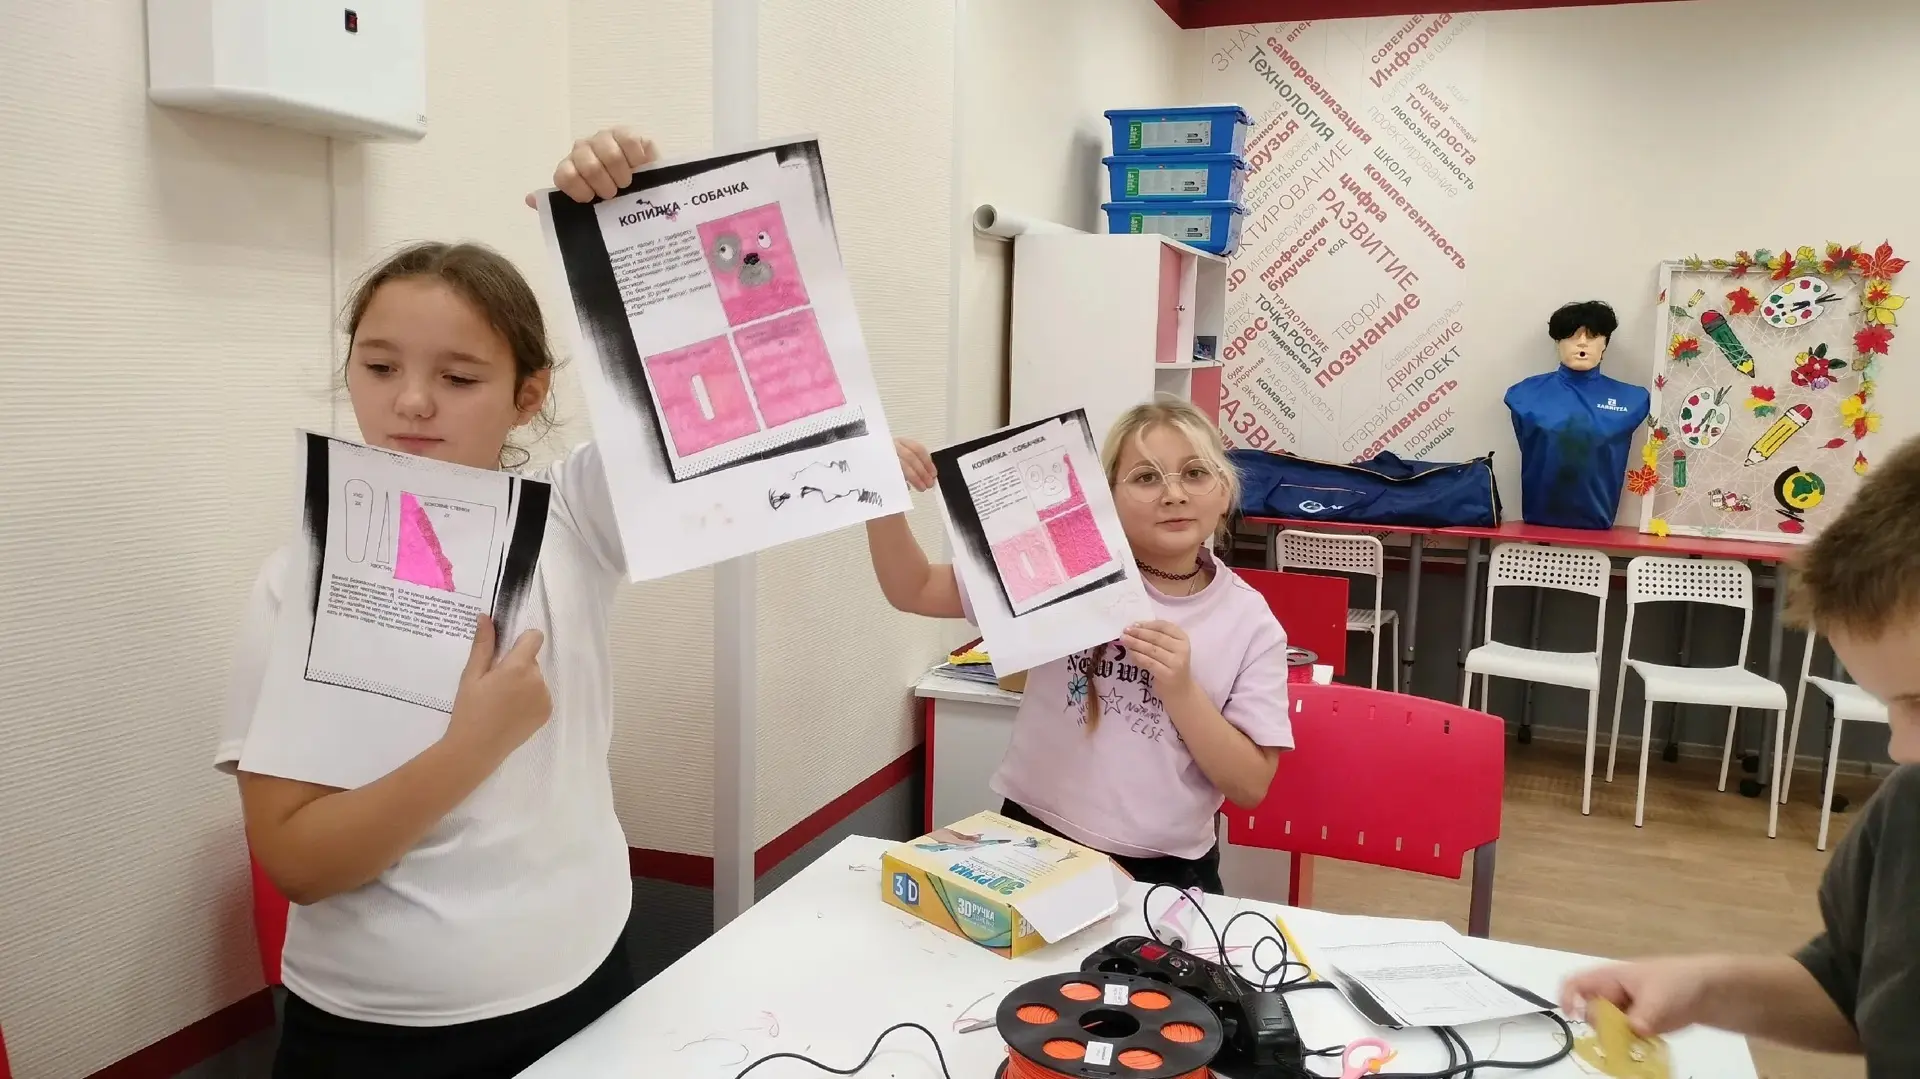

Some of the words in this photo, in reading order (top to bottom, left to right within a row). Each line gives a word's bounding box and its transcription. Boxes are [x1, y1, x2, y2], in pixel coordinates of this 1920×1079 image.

[1248, 45, 1334, 142] Технология
[1266, 36, 1372, 145] самореализация
[1416, 83, 1450, 113] думай
[1373, 146, 1412, 187] ШКОЛА
[1391, 105, 1474, 190] ЛЮБОЗНАТЕЛЬНОСТЬ
[1244, 163, 1284, 207] АСНОСТИ
[1250, 141, 1320, 209] ДЕЯТЕЛЬНОСТИ
[1339, 173, 1387, 223] цифра
[618, 201, 680, 228] КОПИЛКА
[691, 181, 749, 207] СОБАЧКА
[1364, 164, 1466, 270] компетентность
[1260, 217, 1328, 282] профессии
[1268, 238, 1327, 291] будущего
[1317, 188, 1419, 292] РАЗВИТИЕ
[1328, 239, 1348, 256] код
[1223, 317, 1268, 360] ерес
[1255, 293, 1290, 332] ТОЧКА
[1287, 329, 1323, 367] РОСТА
[1273, 293, 1329, 353] ТРУДОЛЮБИЕ
[1314, 293, 1420, 389] познание
[1227, 365, 1244, 380] будь
[1268, 329, 1312, 374] лидерство
[1387, 322, 1463, 392] движение
[1405, 346, 1462, 397] ПРОЕКТ
[1256, 377, 1296, 420] команда
[1264, 368, 1297, 405] РАБОТА
[1242, 384, 1296, 444] аккуратность
[1352, 380, 1458, 463] реативность
[1404, 407, 1455, 452] порядок
[971, 451, 1008, 470] КОПИЛКА
[1012, 436, 1046, 455] СОБАЧКА
[1414, 426, 1455, 460] помощь
[957, 897, 972, 918] 3D
[972, 903, 995, 921] РУЧКА
